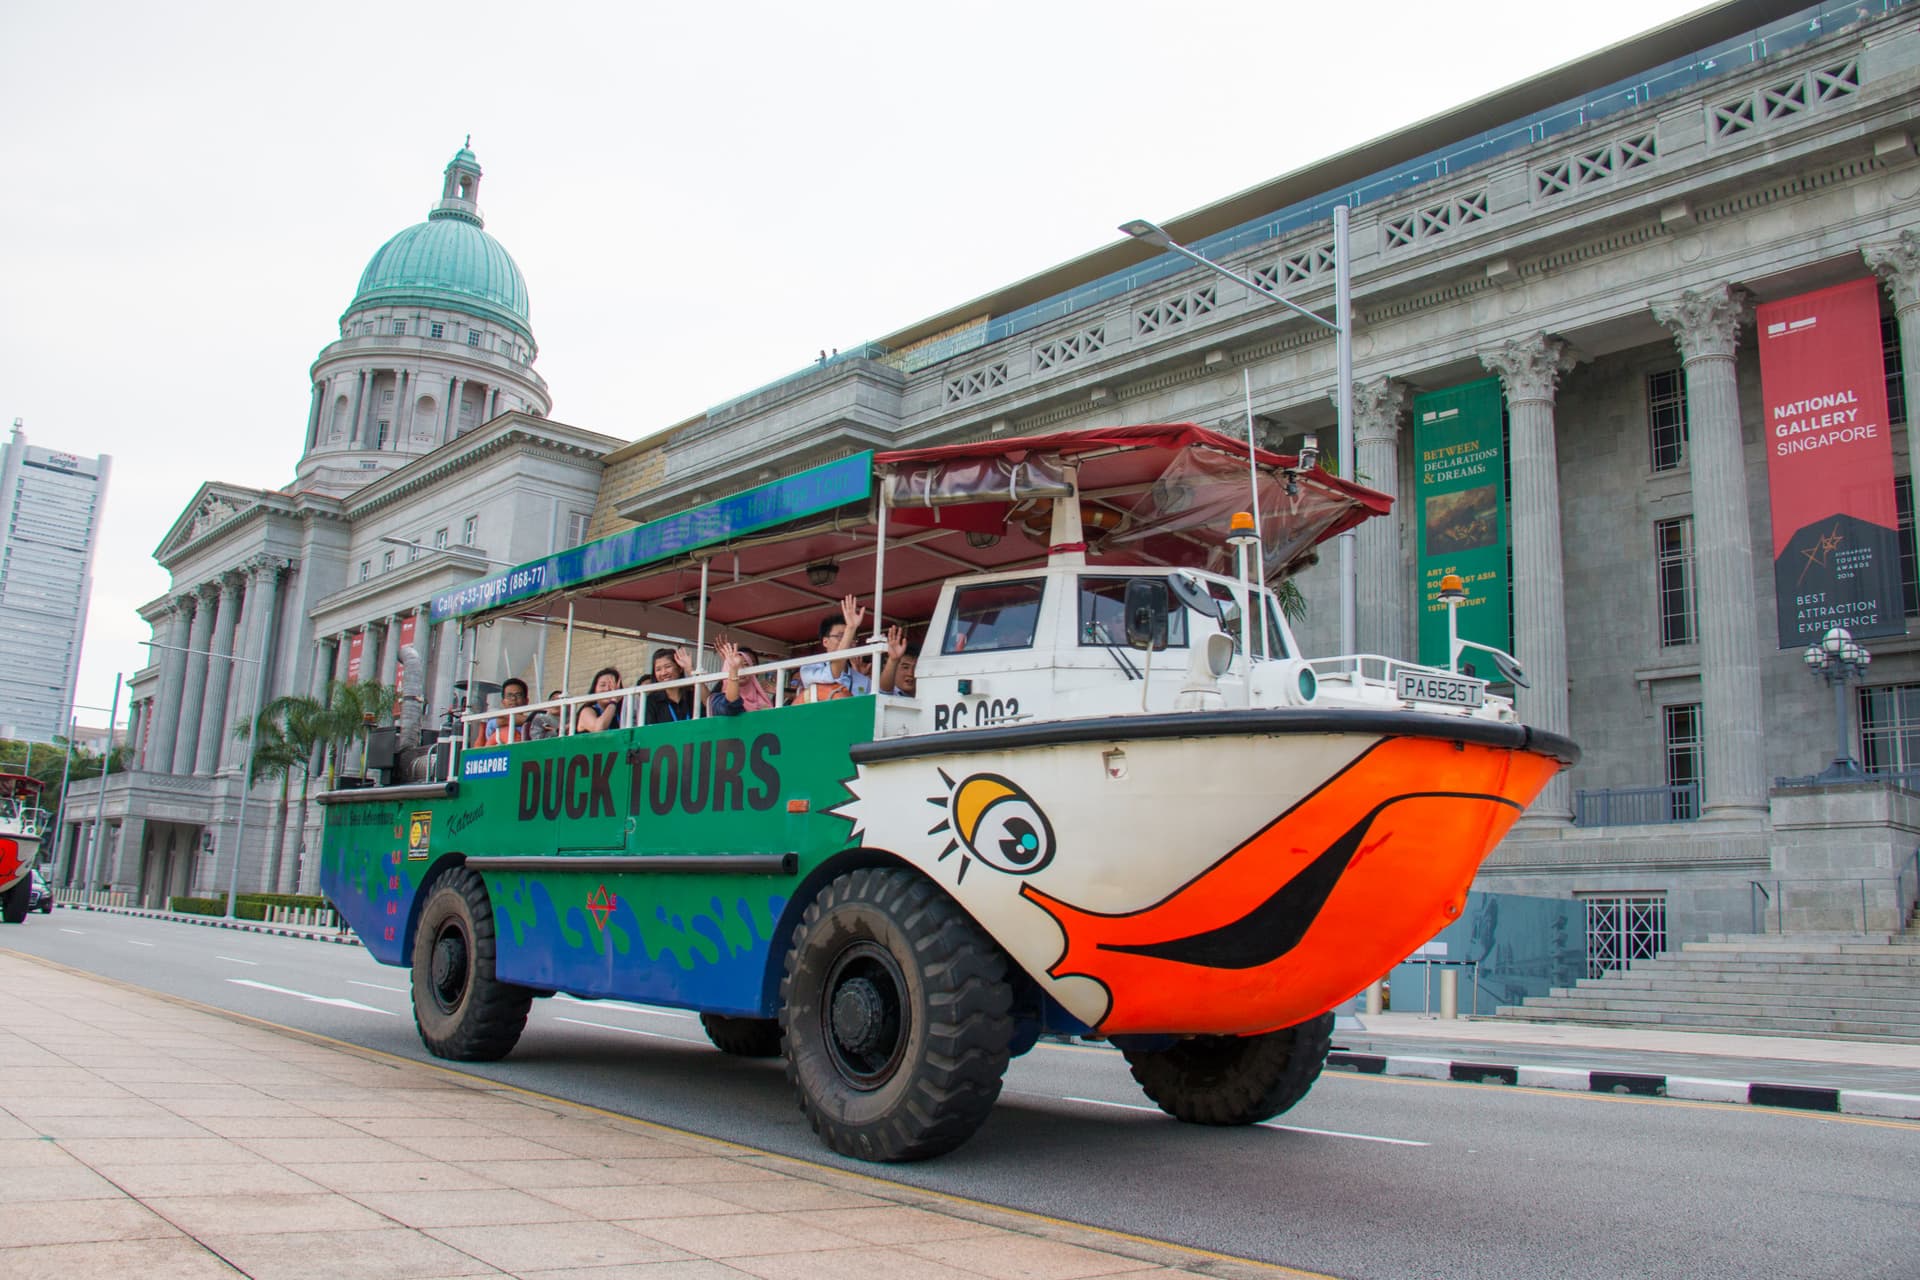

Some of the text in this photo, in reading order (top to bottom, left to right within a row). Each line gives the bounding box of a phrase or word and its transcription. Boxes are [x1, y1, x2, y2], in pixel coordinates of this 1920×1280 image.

[1774, 390, 1857, 419] NATIONAL
[1776, 408, 1858, 437] GALLERY
[1424, 440, 1480, 460] BETWEEN
[1777, 424, 1878, 456] SINGAPORE
[1424, 448, 1498, 472] DECLARATIONS
[1424, 463, 1486, 484] & DREAMS:
[815, 473, 850, 497] Tour
[1836, 554, 1872, 564] TOURISM
[1836, 562, 1870, 571] AWARDS
[509, 565, 547, 595] (868-77)
[1427, 568, 1442, 577] ART
[1477, 571, 1496, 581] ASIA
[1454, 596, 1486, 609] ENTURY
[1796, 592, 1826, 605] BEST
[1798, 600, 1877, 619] ATTRACTION
[1799, 614, 1879, 633] EXPERIENCE
[1405, 678, 1477, 703] PA6525T
[935, 702, 967, 731] RC
[465, 756, 508, 775] SINGAPORE
[518, 732, 781, 821] DUCK TOURS
